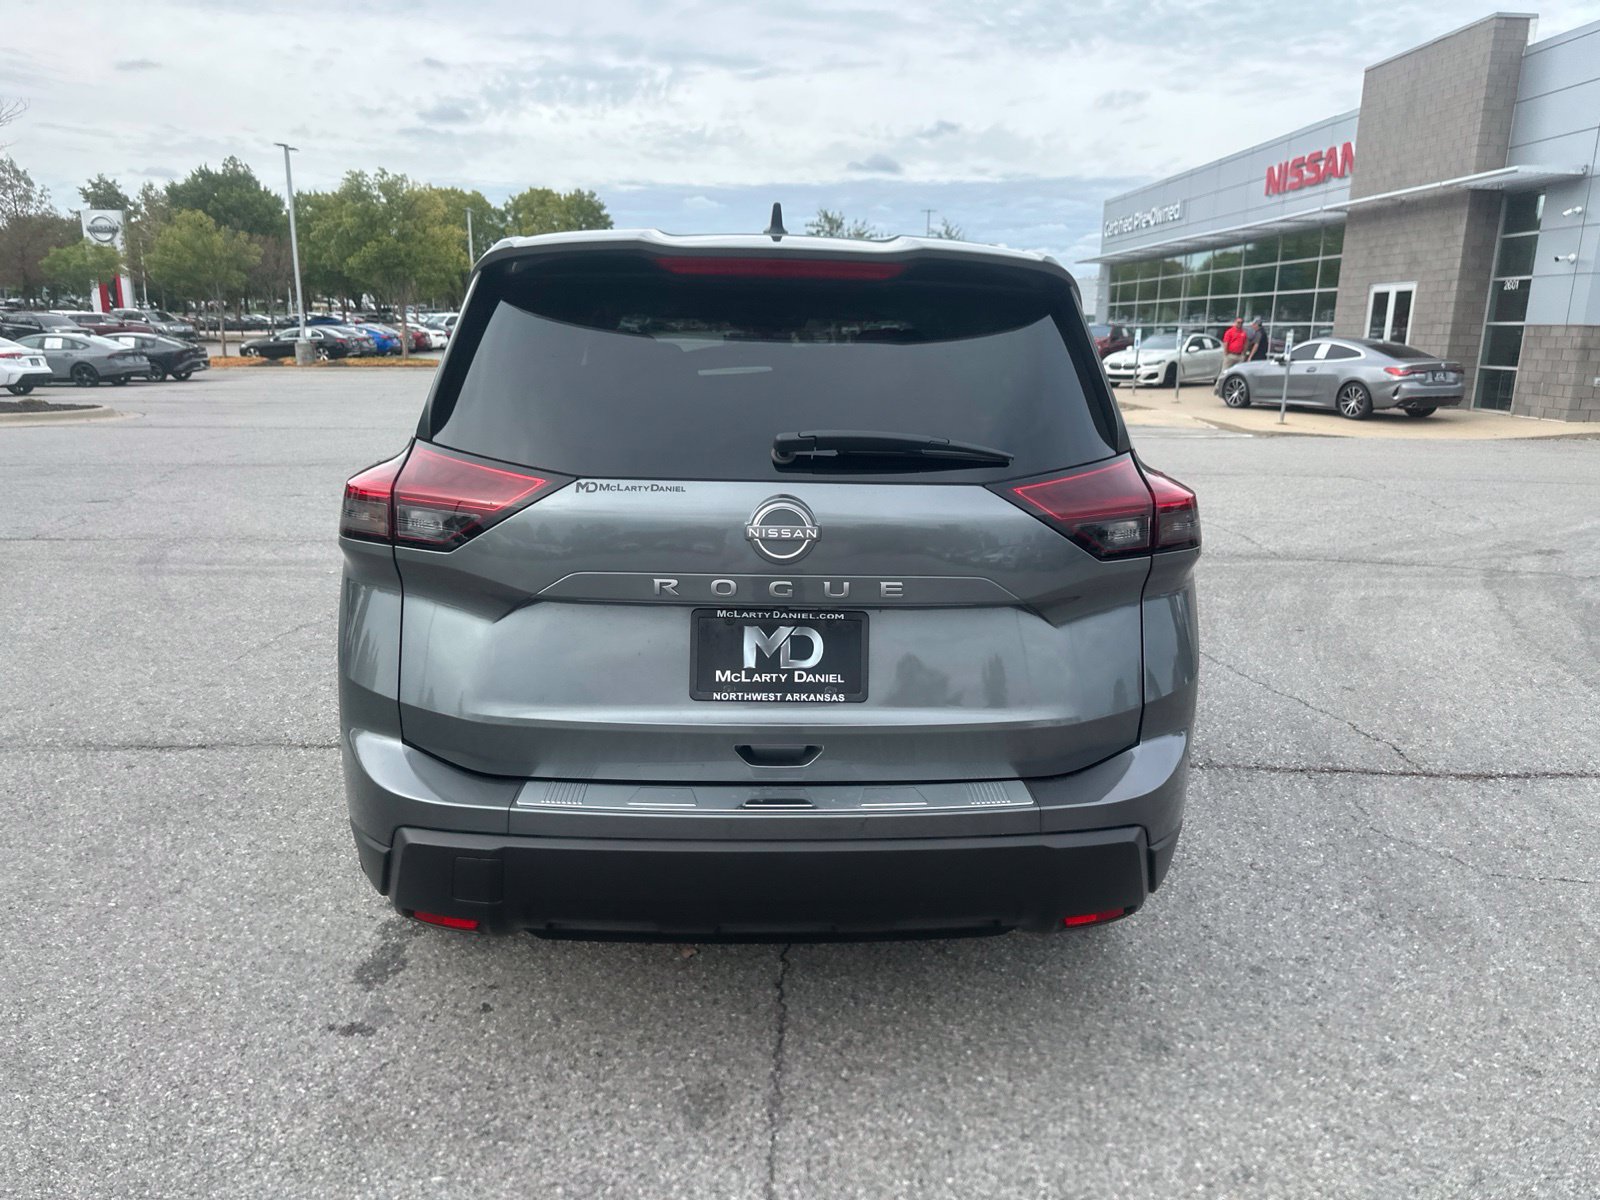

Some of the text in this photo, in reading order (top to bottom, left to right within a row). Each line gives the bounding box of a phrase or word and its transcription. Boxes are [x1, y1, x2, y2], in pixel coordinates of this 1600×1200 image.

[1264, 141, 1355, 197] NISSAN
[1104, 199, 1180, 238] Certified Pre-Owned
[748, 527, 817, 539] NISSAN
[653, 578, 904, 598] ROGUE
[743, 625, 824, 669] MD
[715, 670, 845, 683] McLarty Daniel
[712, 692, 845, 702] NORTHWEST ARKANSAS
